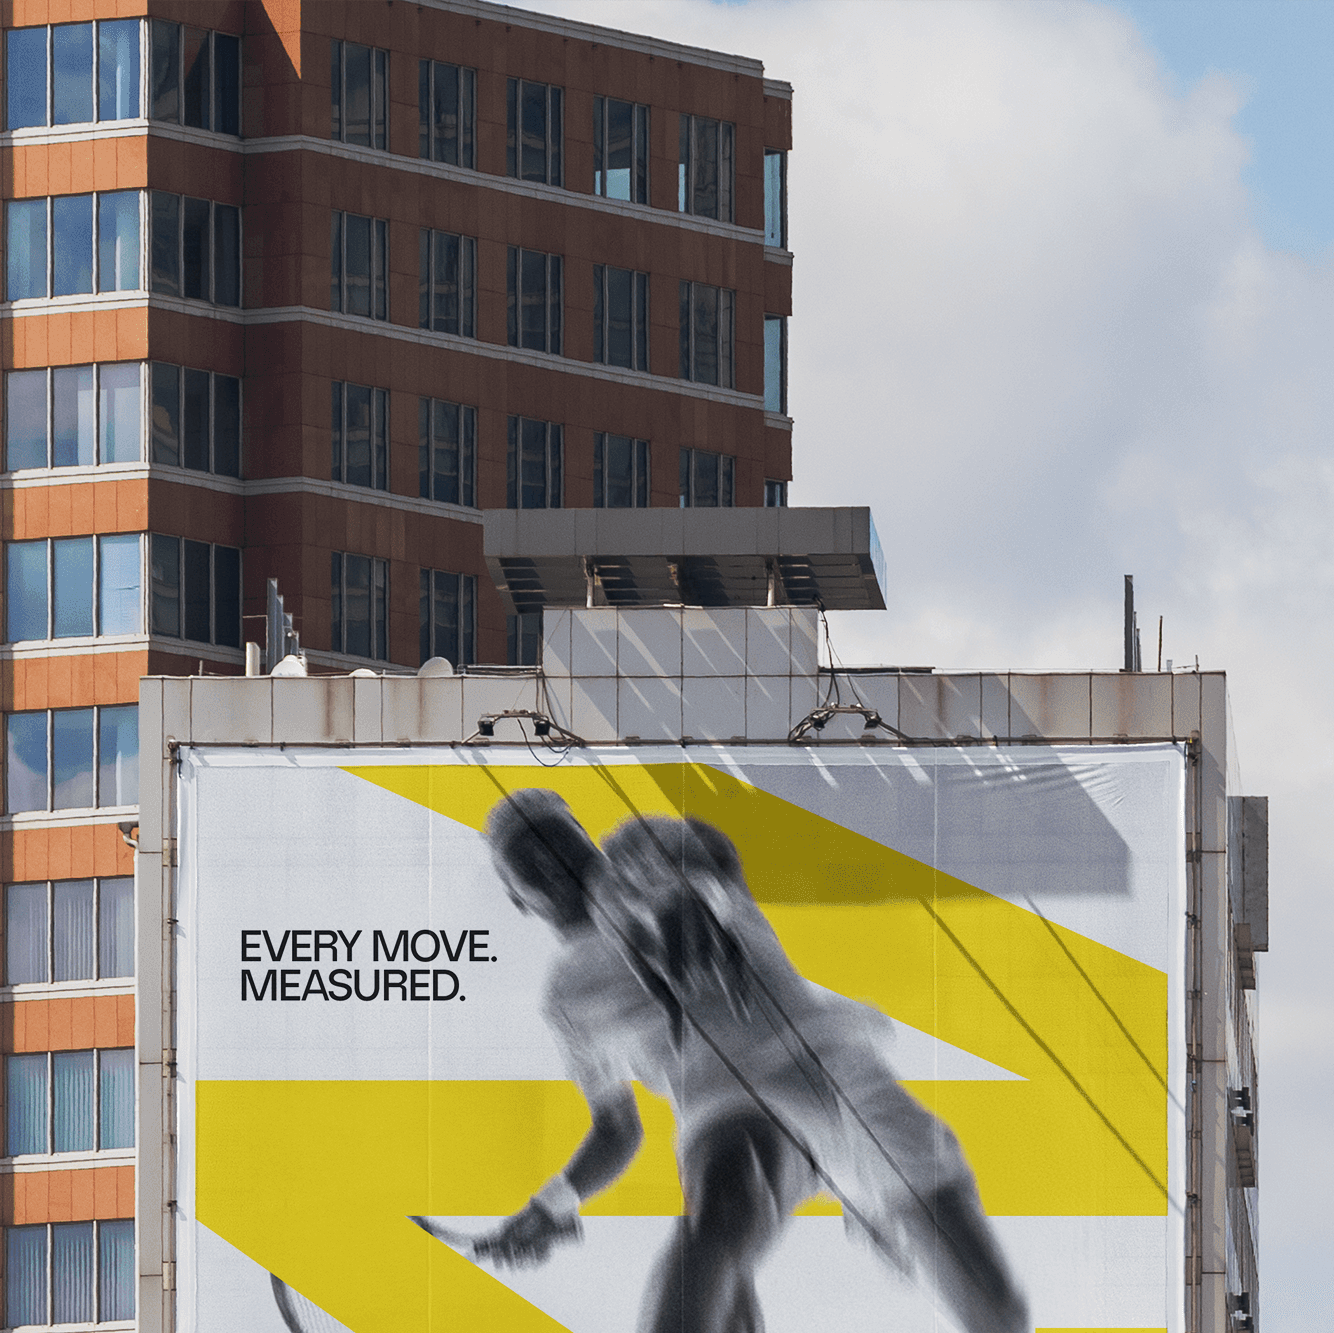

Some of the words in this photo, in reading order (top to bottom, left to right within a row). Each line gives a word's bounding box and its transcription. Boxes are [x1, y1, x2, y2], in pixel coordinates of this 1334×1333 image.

[241, 930, 362, 962] EVERY
[373, 929, 498, 963] MOVE.
[241, 968, 466, 1002] MEASURED.
